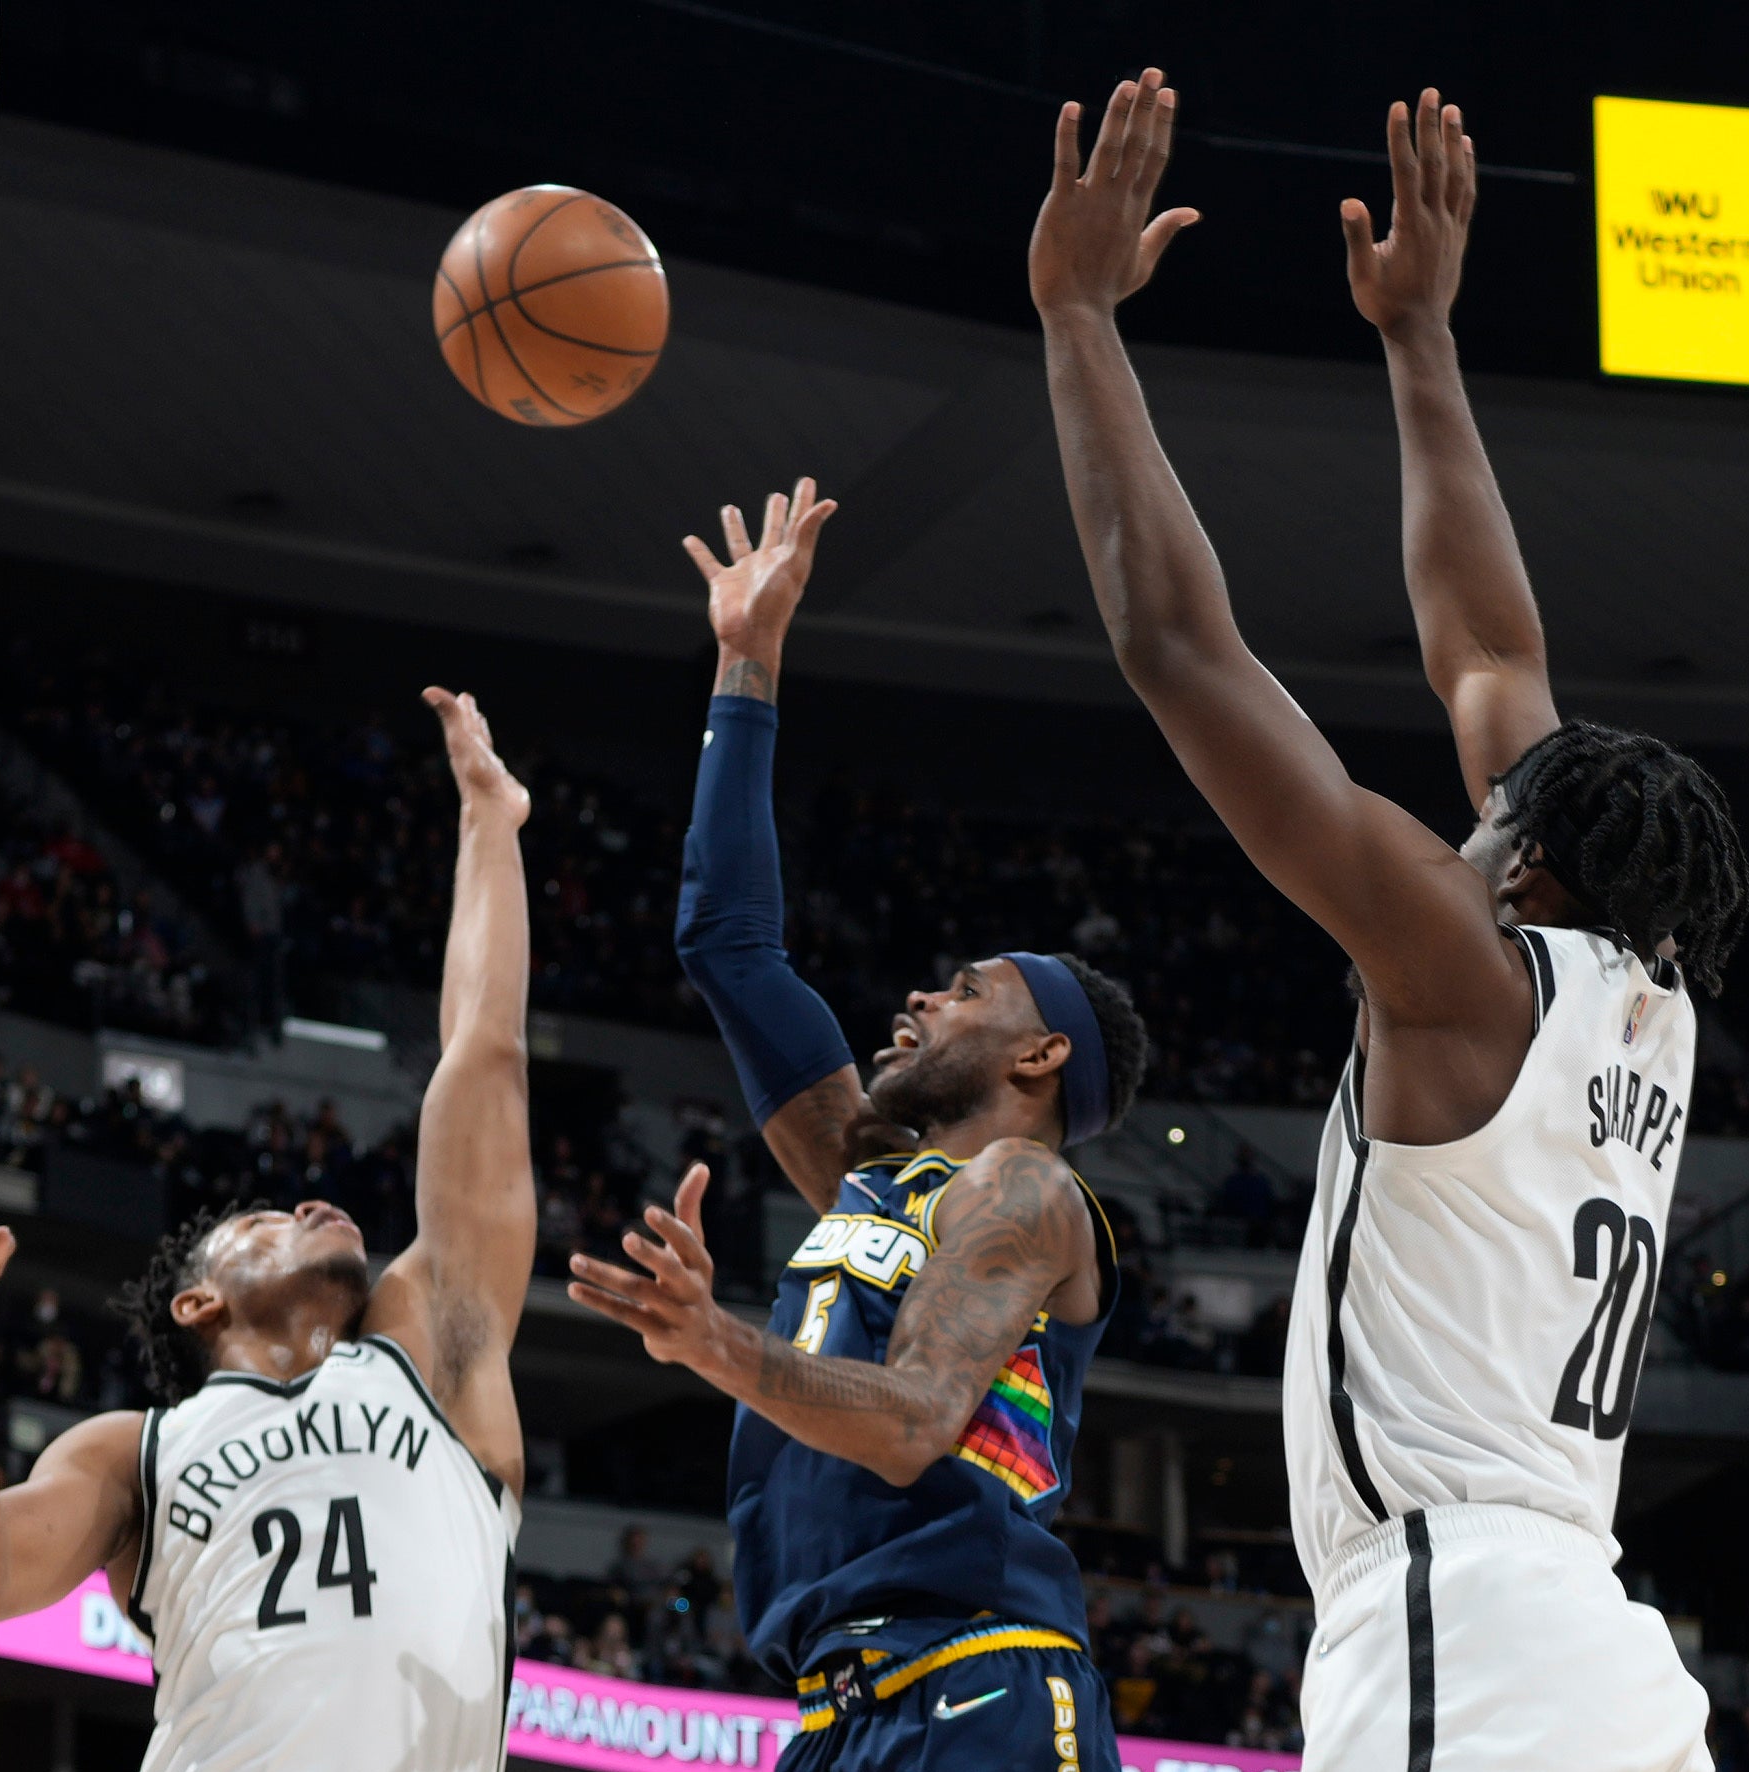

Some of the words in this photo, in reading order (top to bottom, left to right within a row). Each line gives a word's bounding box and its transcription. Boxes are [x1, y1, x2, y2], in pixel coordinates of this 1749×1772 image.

[1638, 261, 1741, 293] Union
[1551, 1197, 1657, 1441] 20
[169, 1402, 429, 1543] BROOKLYN
[252, 1495, 377, 1631] 24
[508, 1676, 765, 1769] PARAMOUNT
